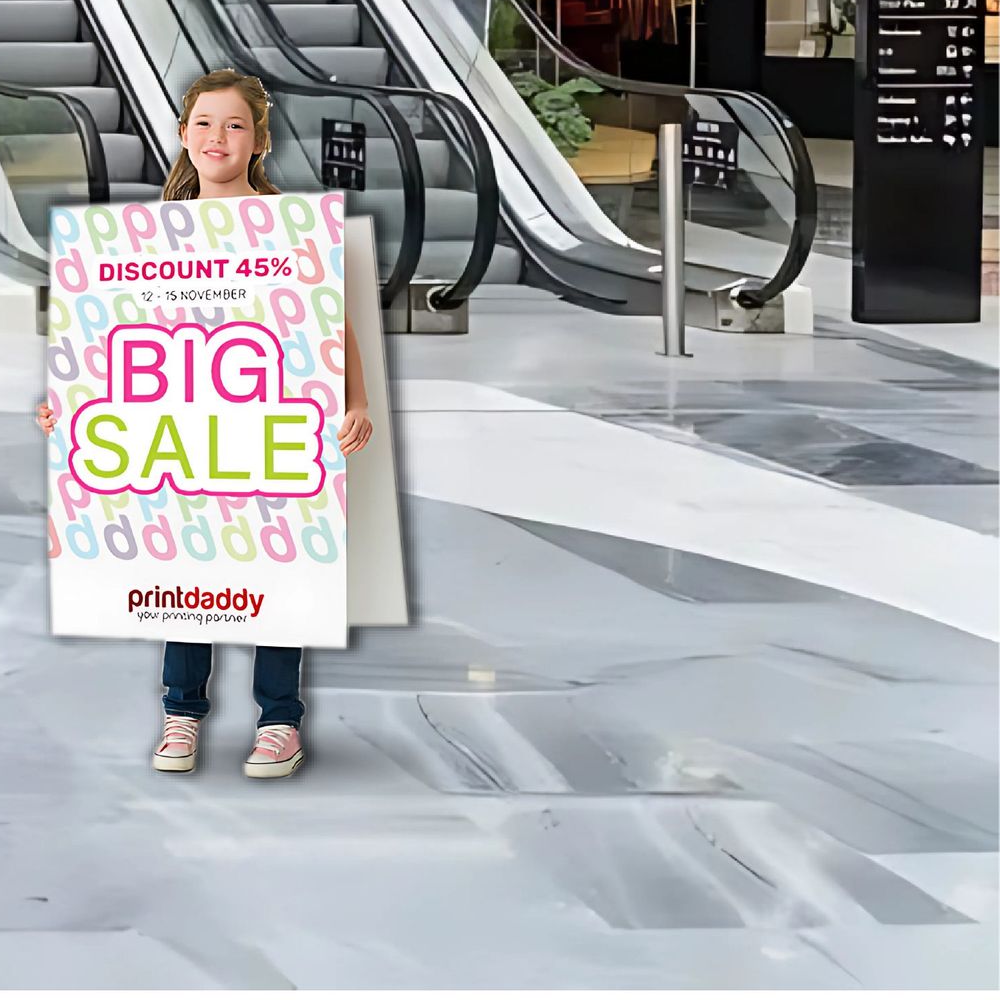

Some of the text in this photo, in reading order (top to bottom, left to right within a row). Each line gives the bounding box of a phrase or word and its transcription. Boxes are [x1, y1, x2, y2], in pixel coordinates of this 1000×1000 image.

[99, 256, 292, 282] DISCOUNT 45%
[181, 288, 247, 301] NOVEMBER
[123, 337, 267, 404] BIG
[83, 412, 309, 481] SALE
[128, 585, 265, 618] printdaddy
